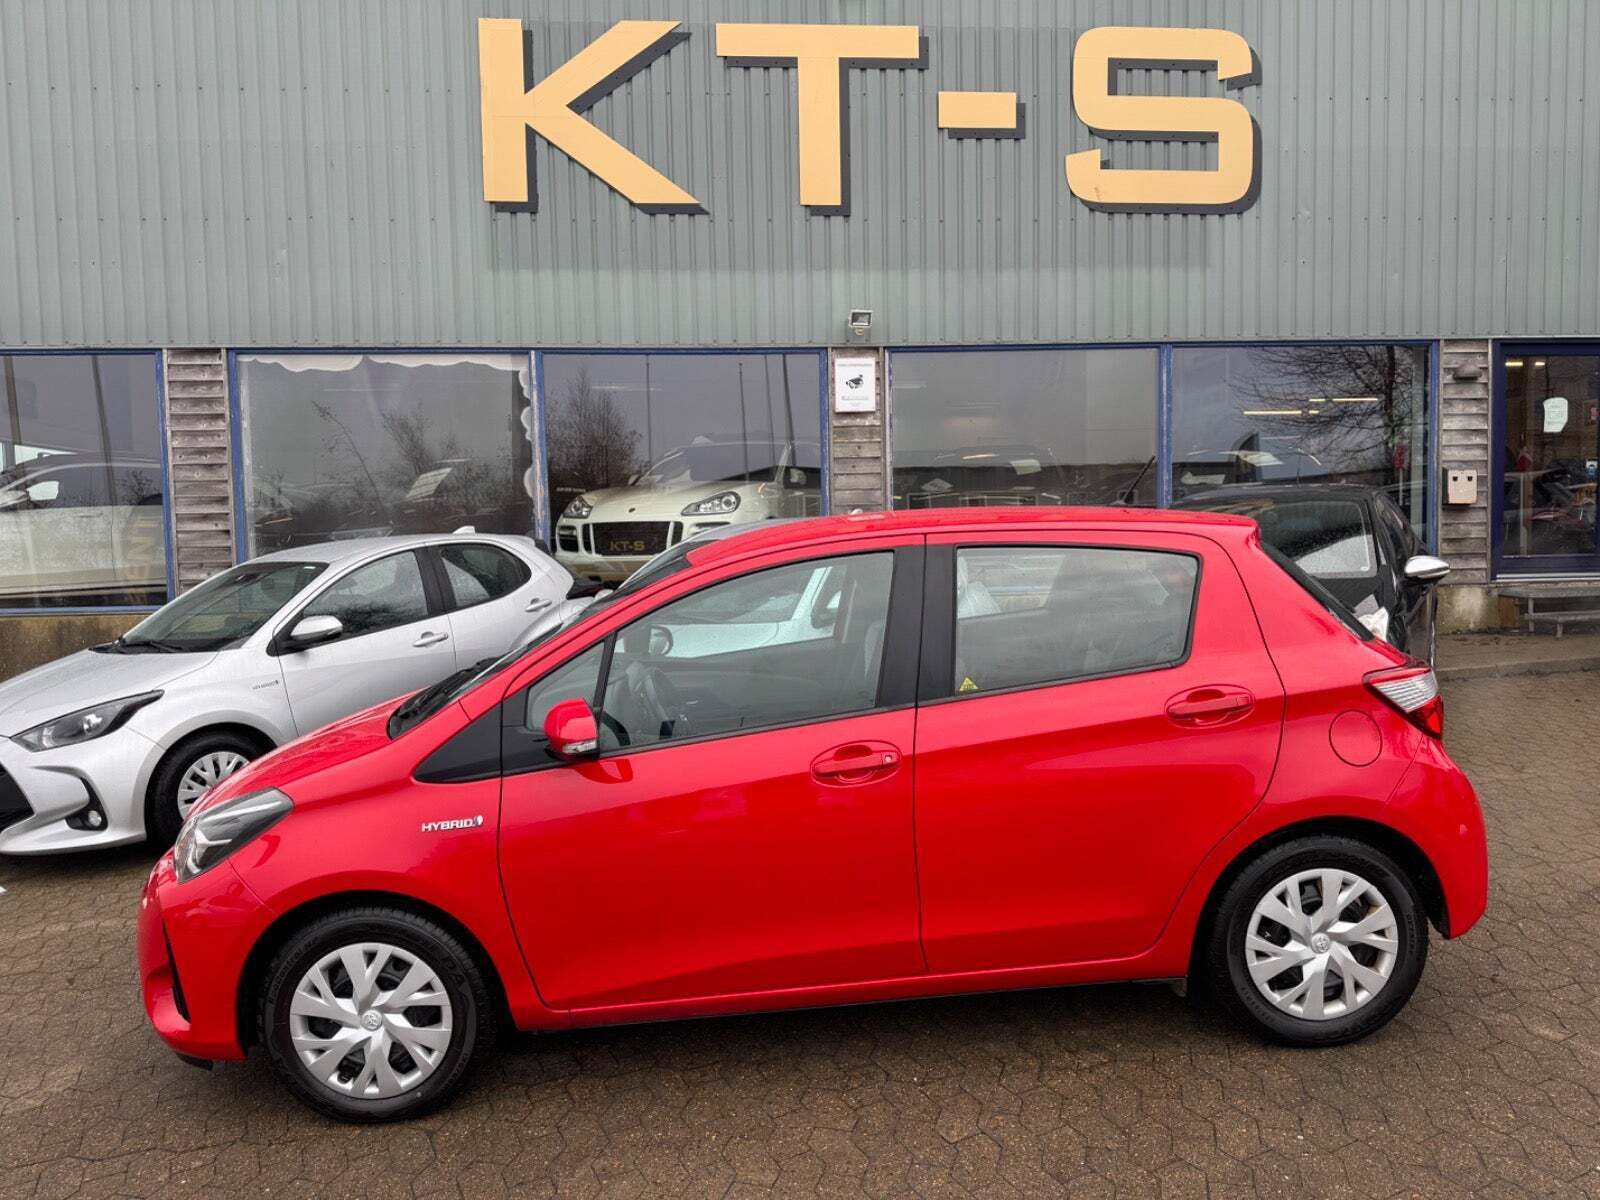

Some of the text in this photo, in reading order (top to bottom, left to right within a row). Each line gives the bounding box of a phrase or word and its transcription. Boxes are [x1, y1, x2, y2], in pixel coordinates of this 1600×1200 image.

[478, 17, 1256, 208] KT-S
[609, 540, 646, 551] KT-S
[421, 818, 474, 832] HYBRID
